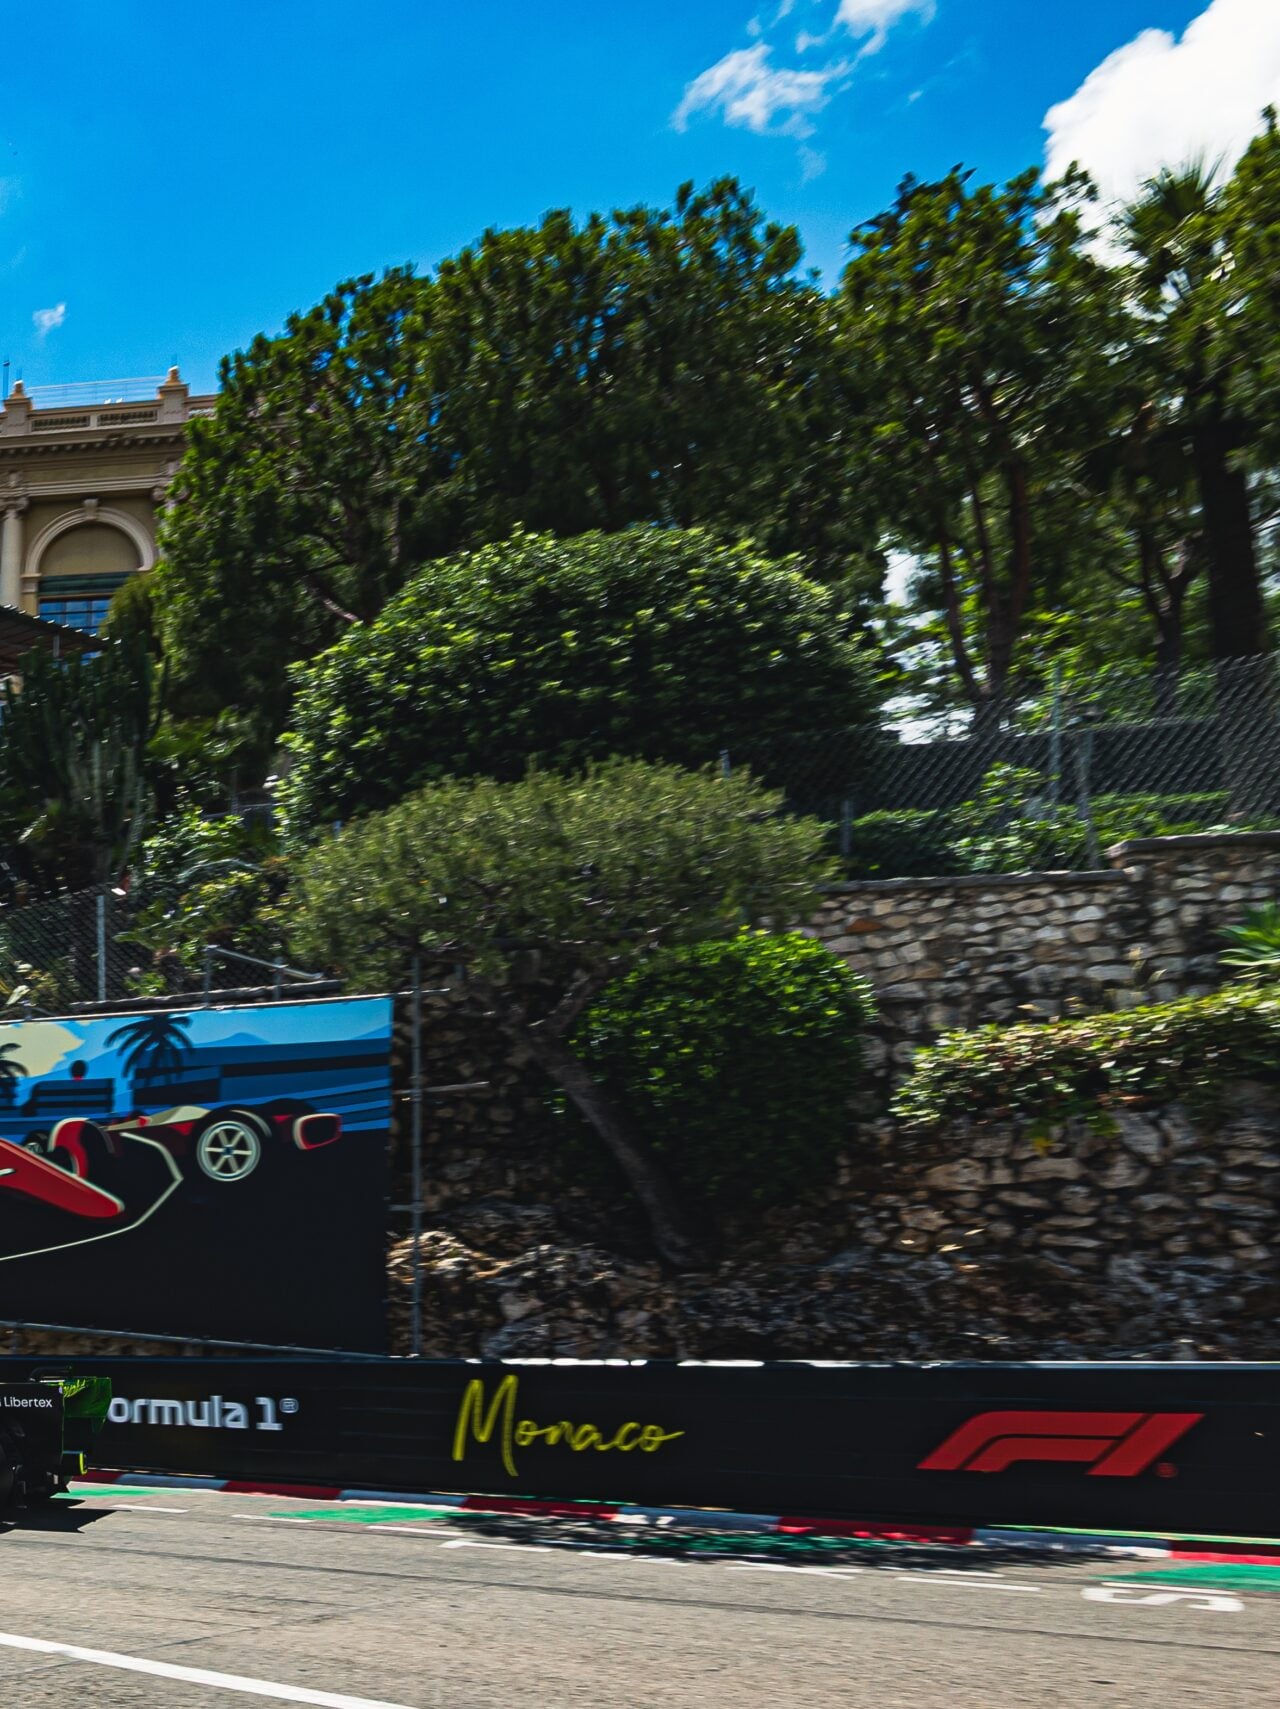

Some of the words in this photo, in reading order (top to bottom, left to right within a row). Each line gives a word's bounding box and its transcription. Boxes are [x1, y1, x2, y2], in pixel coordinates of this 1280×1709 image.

[4, 1396, 53, 1408] Libertex
[108, 1395, 248, 1430] ormula
[452, 1374, 685, 1477] Monaco
